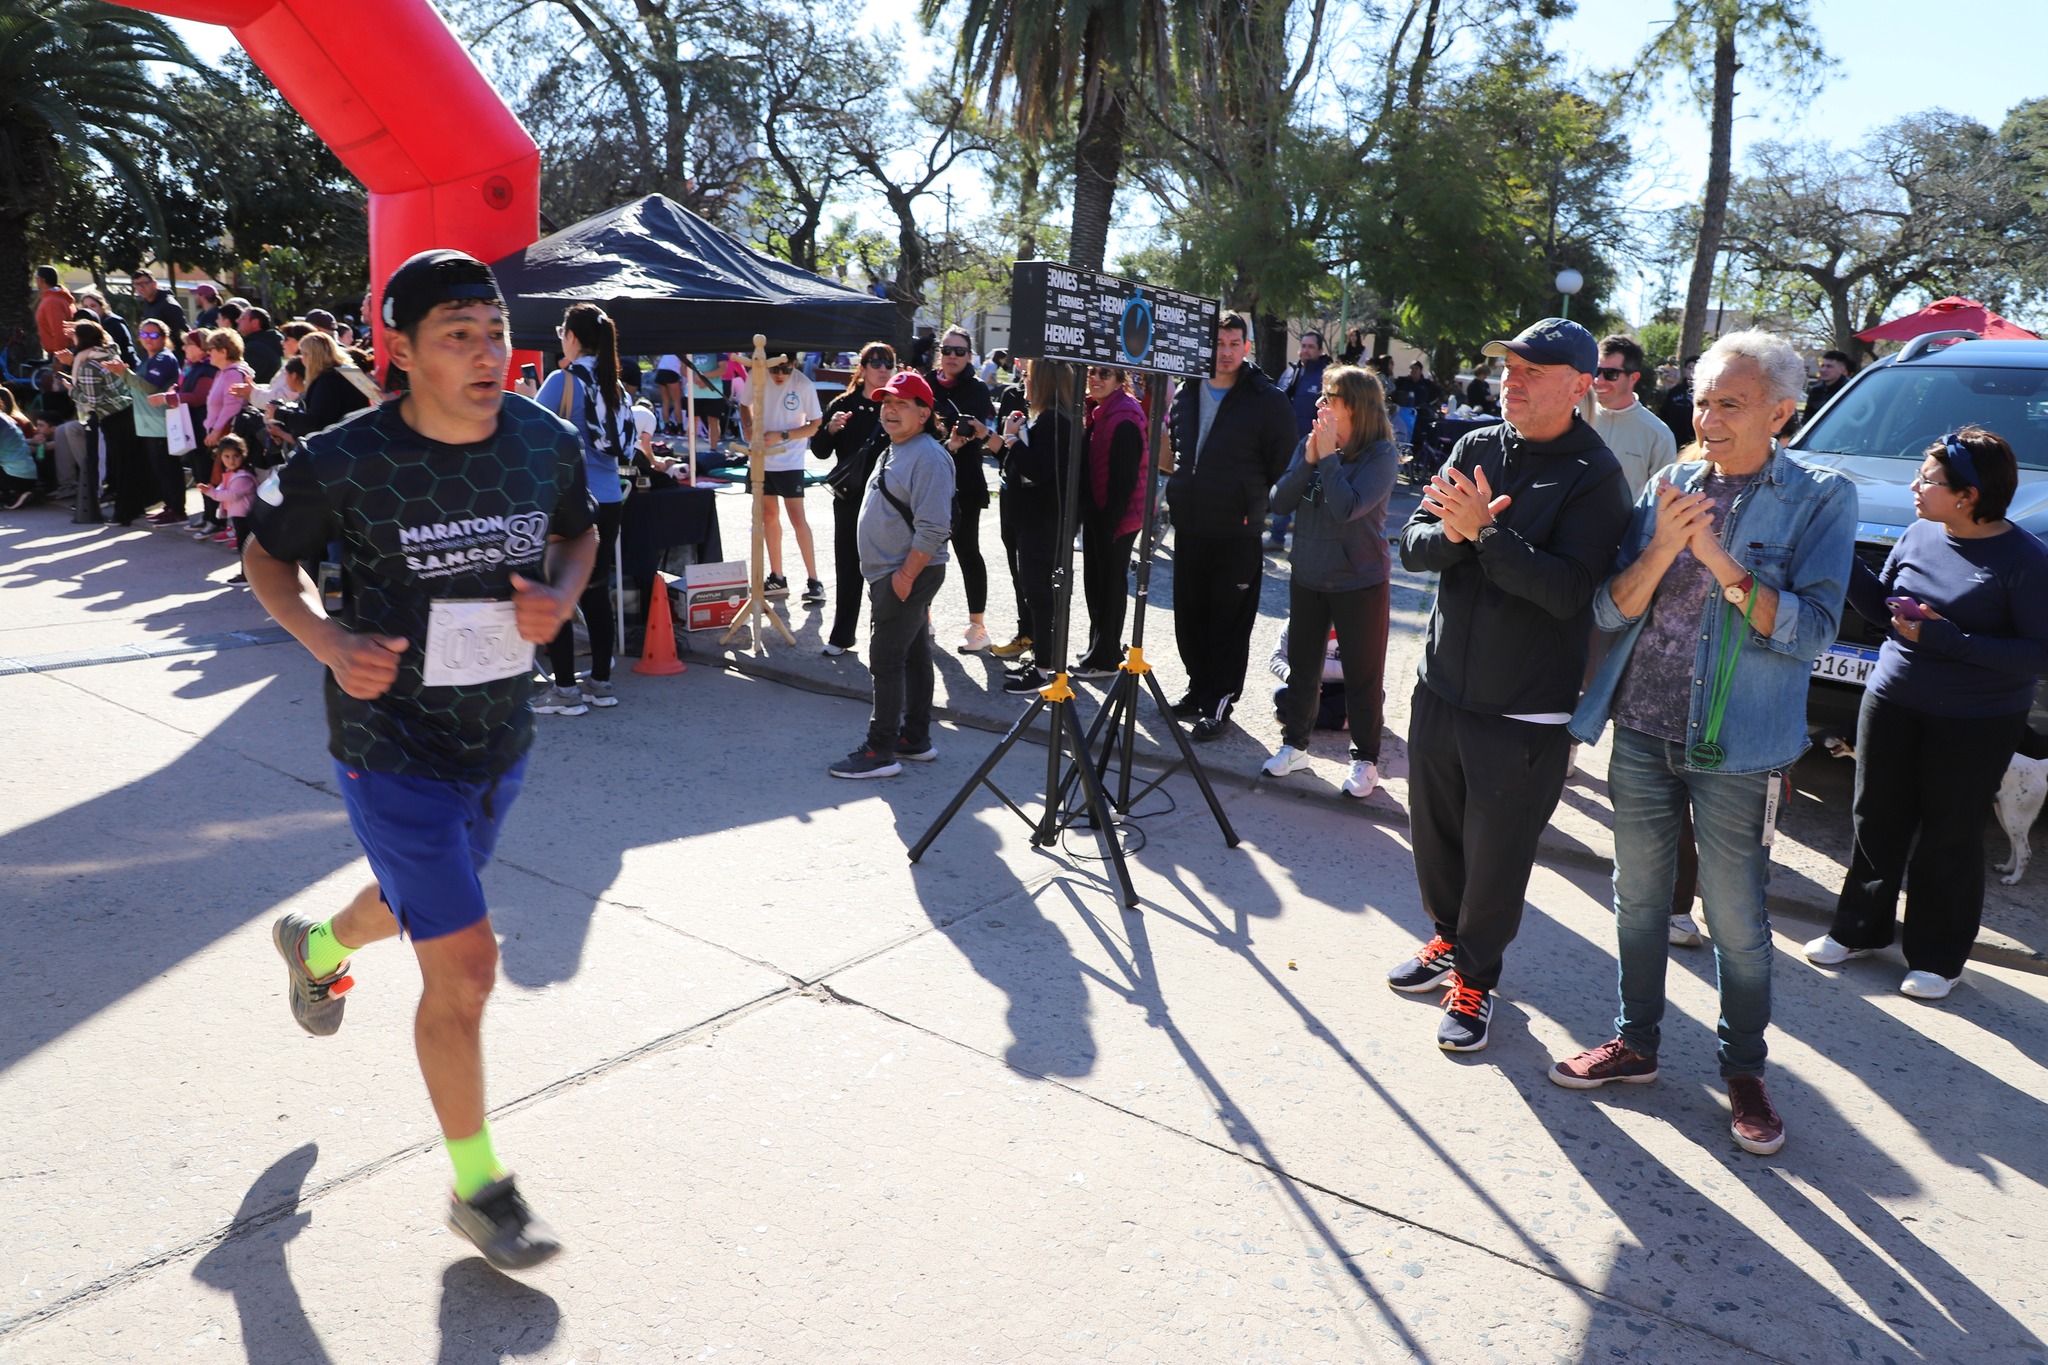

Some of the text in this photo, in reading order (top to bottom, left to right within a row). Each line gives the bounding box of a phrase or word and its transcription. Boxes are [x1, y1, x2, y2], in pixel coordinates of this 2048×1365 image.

[1057, 293, 1085, 310] HERMES
[1154, 303, 1187, 326] HERMES
[1044, 323, 1086, 347] HERMES
[1153, 351, 1186, 372] HERMES
[398, 515, 505, 545] MARATON
